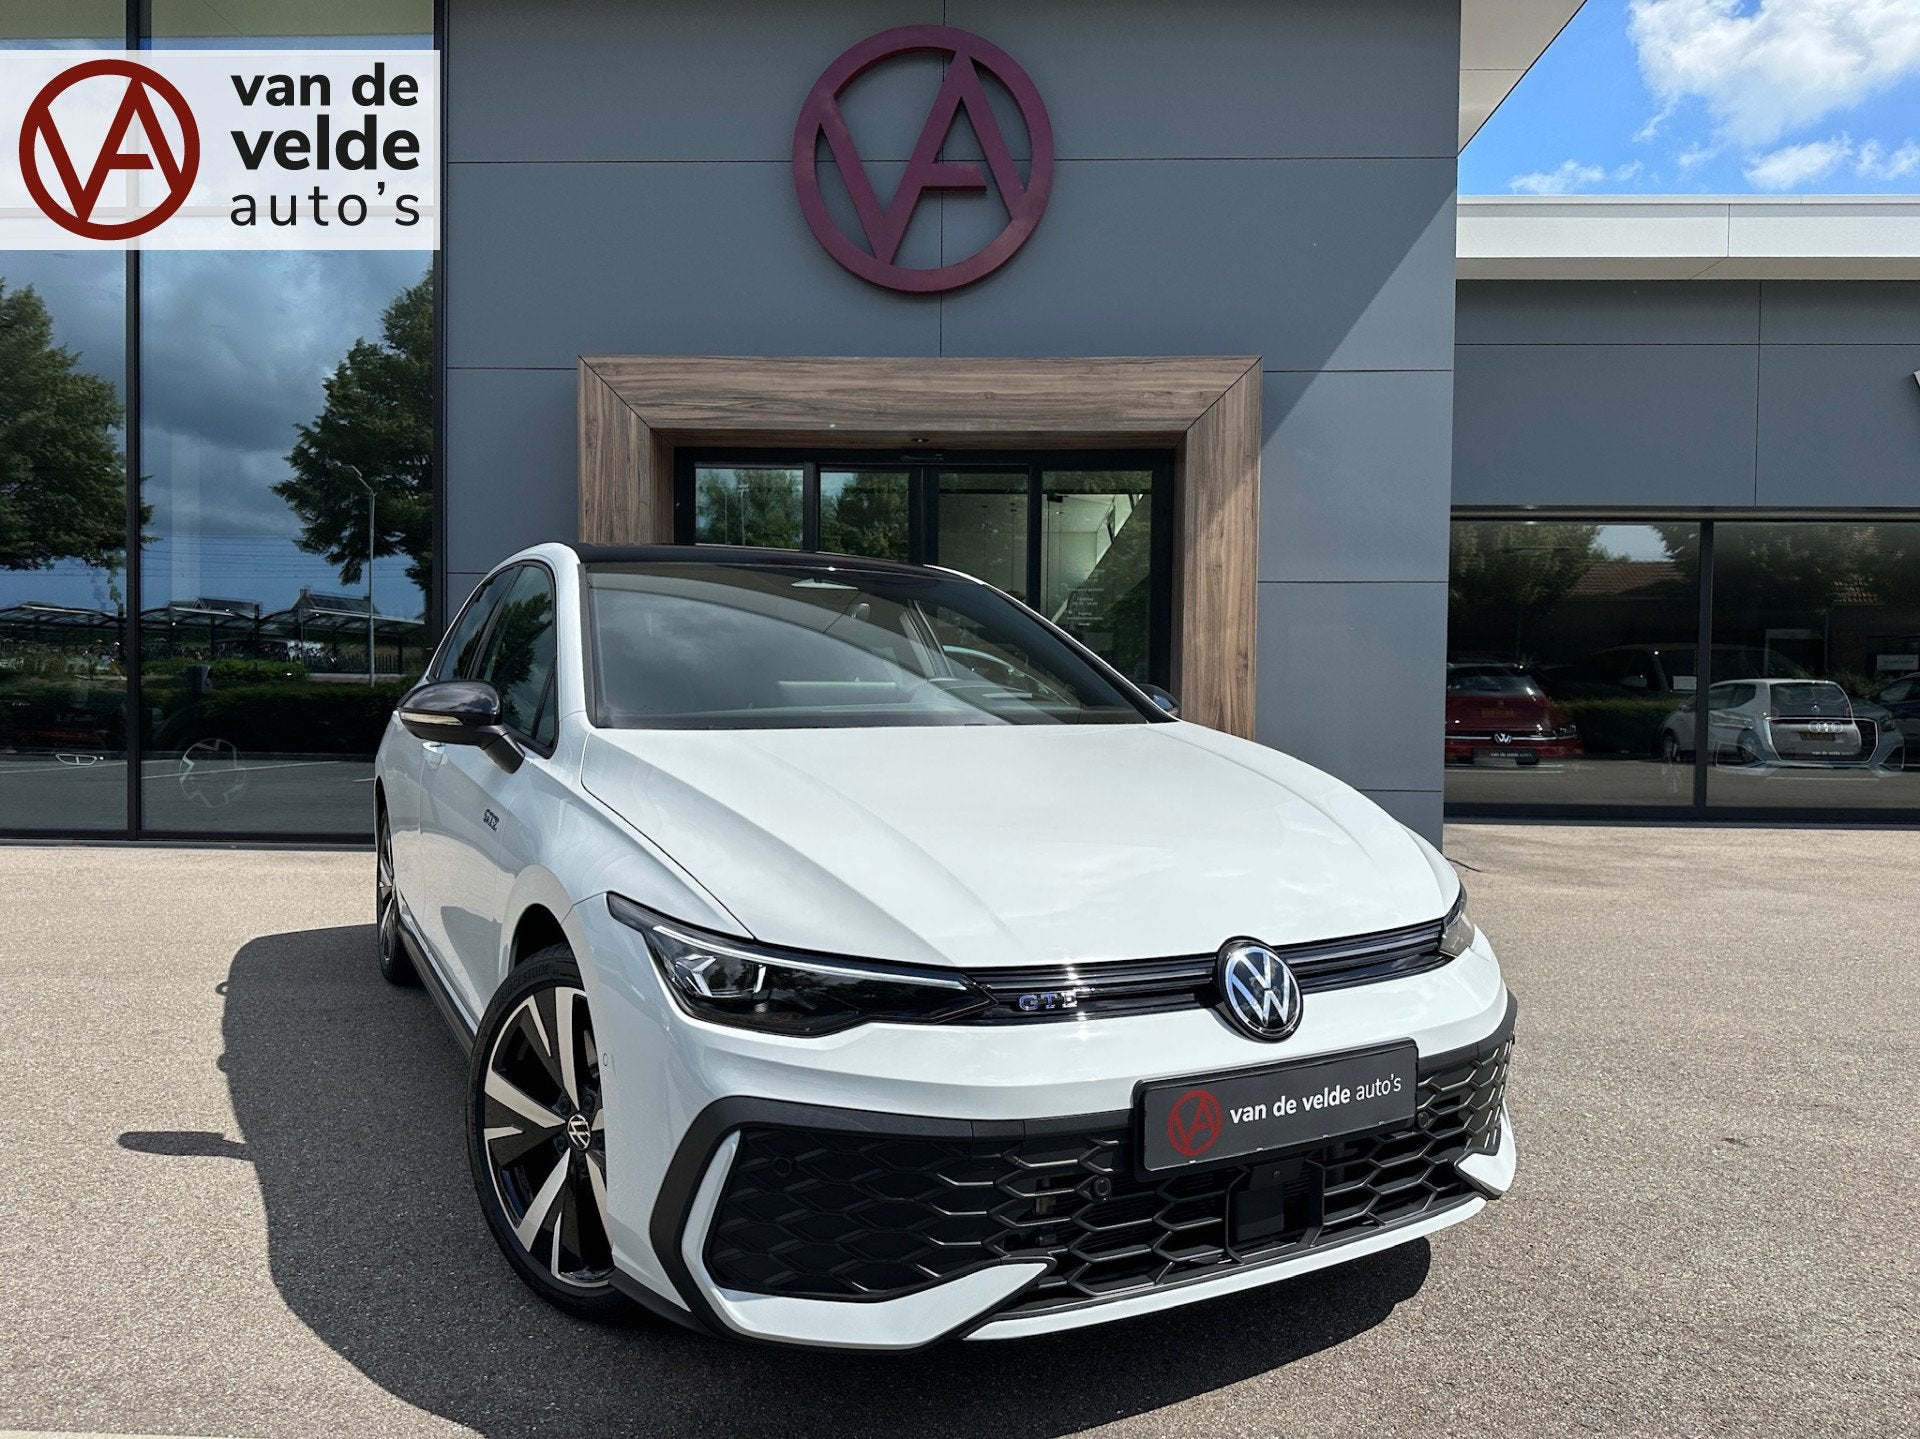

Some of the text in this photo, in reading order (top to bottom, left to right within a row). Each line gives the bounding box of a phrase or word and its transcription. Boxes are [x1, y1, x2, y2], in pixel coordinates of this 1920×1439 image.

[1018, 992, 1078, 1011] GTE
[1230, 1073, 1402, 1124] van de velde auto’s
